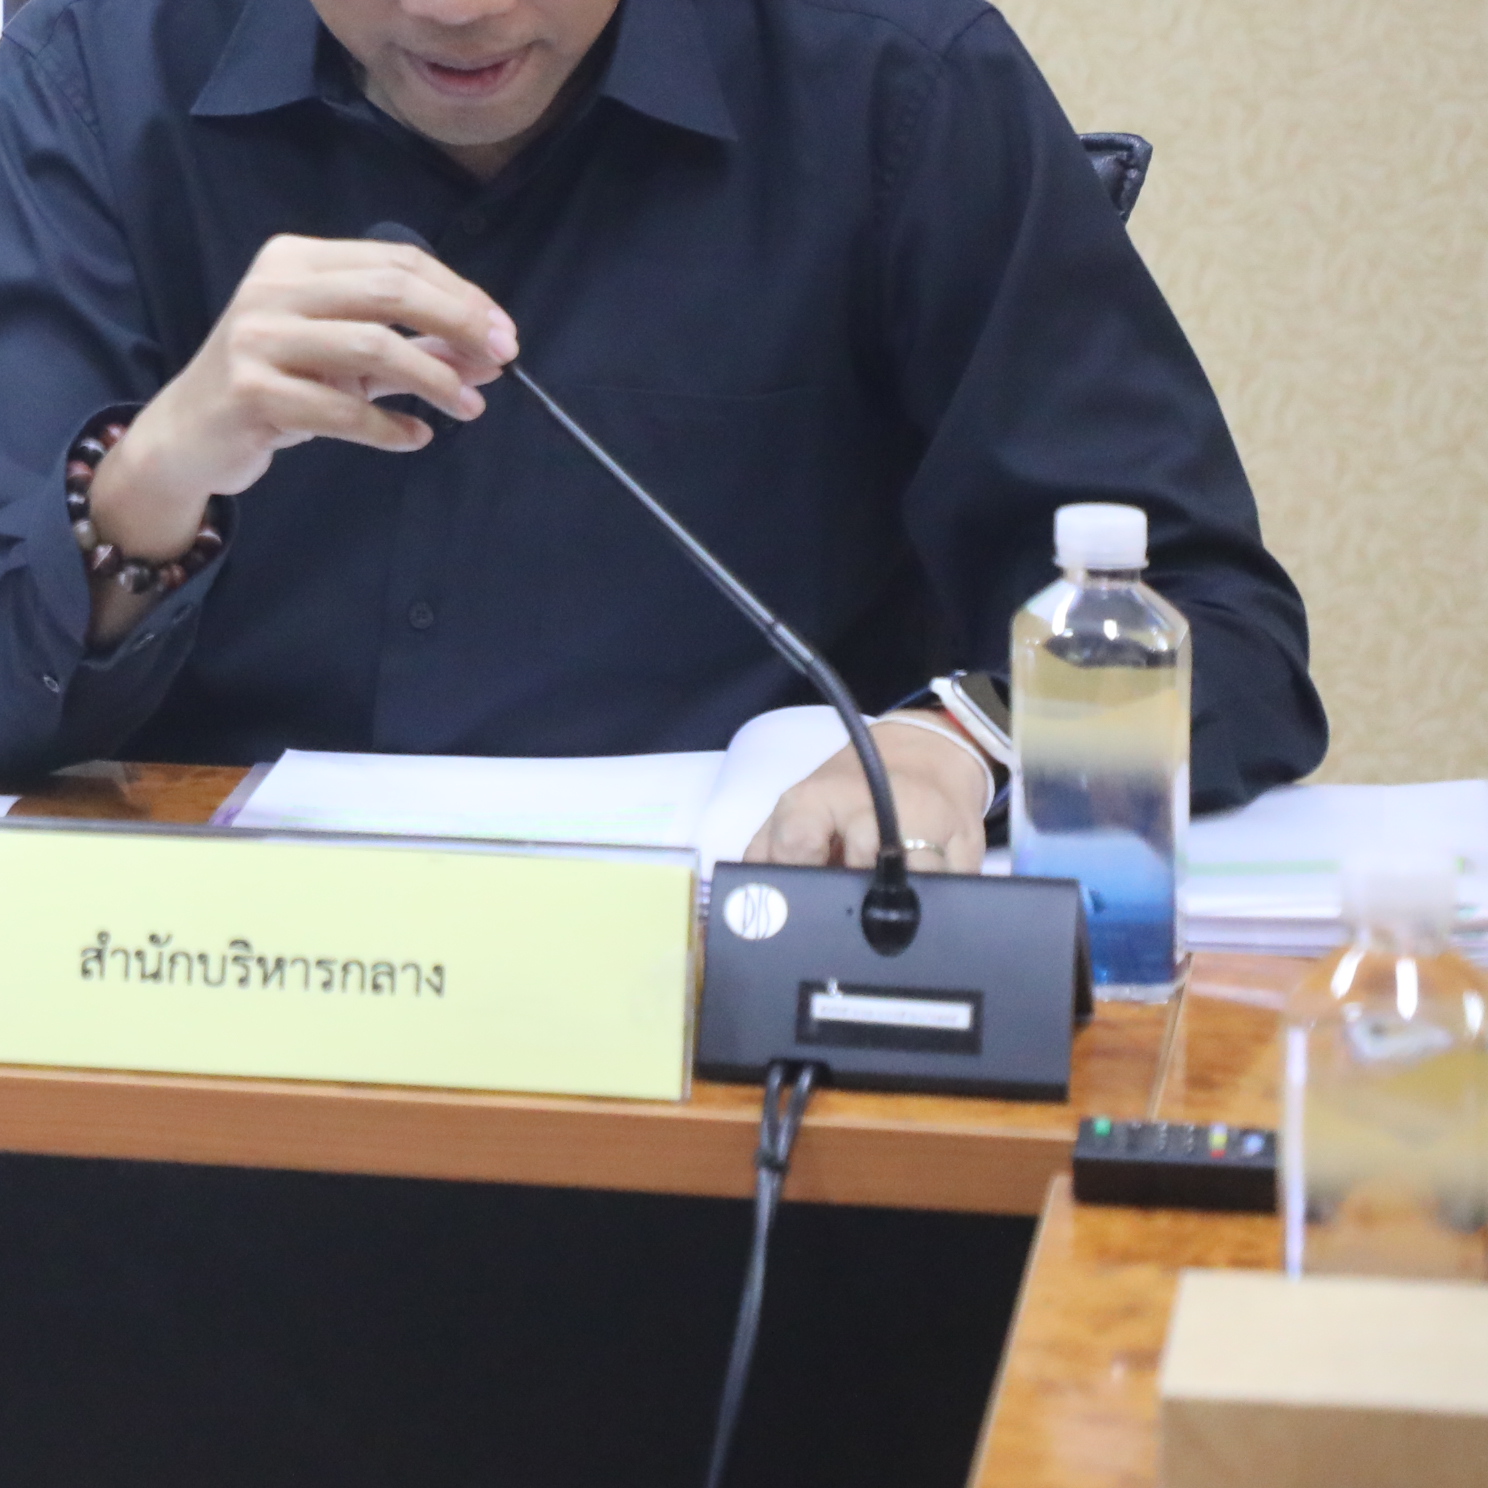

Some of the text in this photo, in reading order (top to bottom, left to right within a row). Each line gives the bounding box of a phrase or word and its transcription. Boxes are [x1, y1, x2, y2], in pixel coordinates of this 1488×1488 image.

[79, 931, 446, 998] สำนักบริหารกลาง
